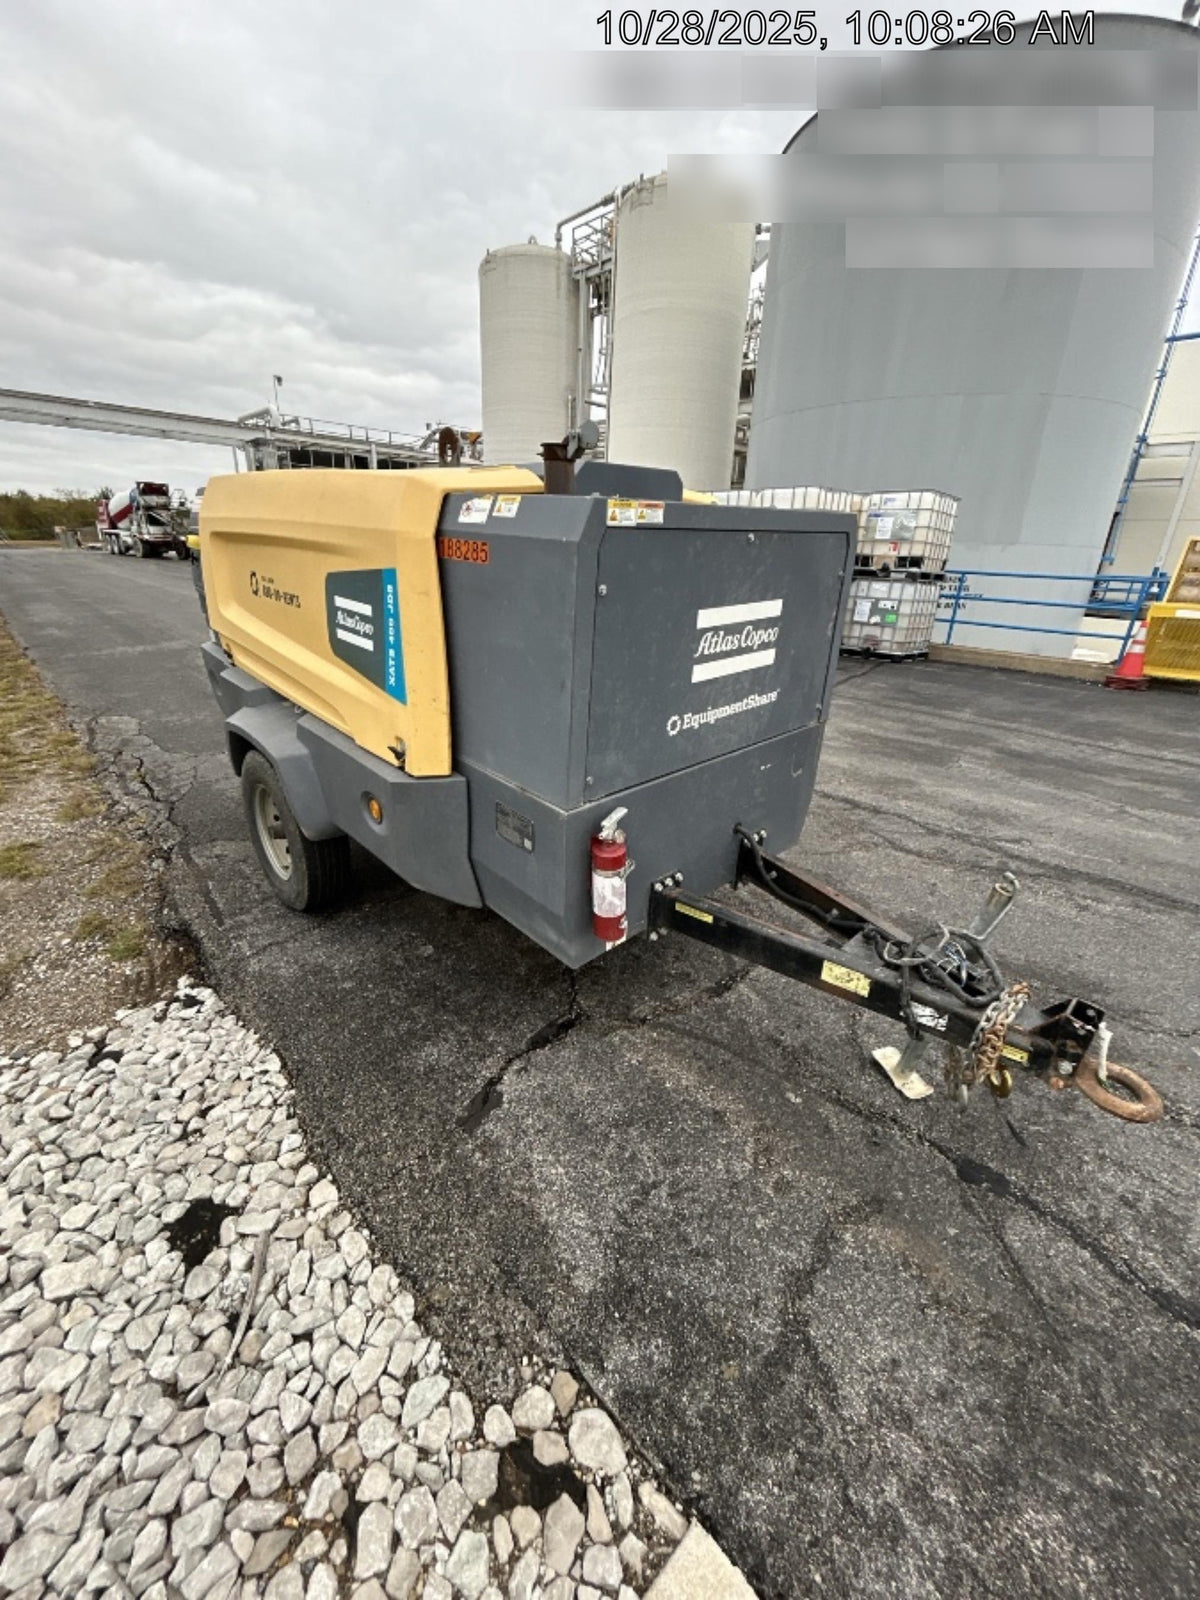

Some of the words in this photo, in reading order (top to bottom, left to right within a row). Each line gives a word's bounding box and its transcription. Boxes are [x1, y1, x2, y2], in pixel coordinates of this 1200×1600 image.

[440, 538, 488, 562] 188285
[694, 630, 741, 657] Atlas
[740, 625, 779, 649] Copco
[682, 690, 778, 729] EquipmentShare
